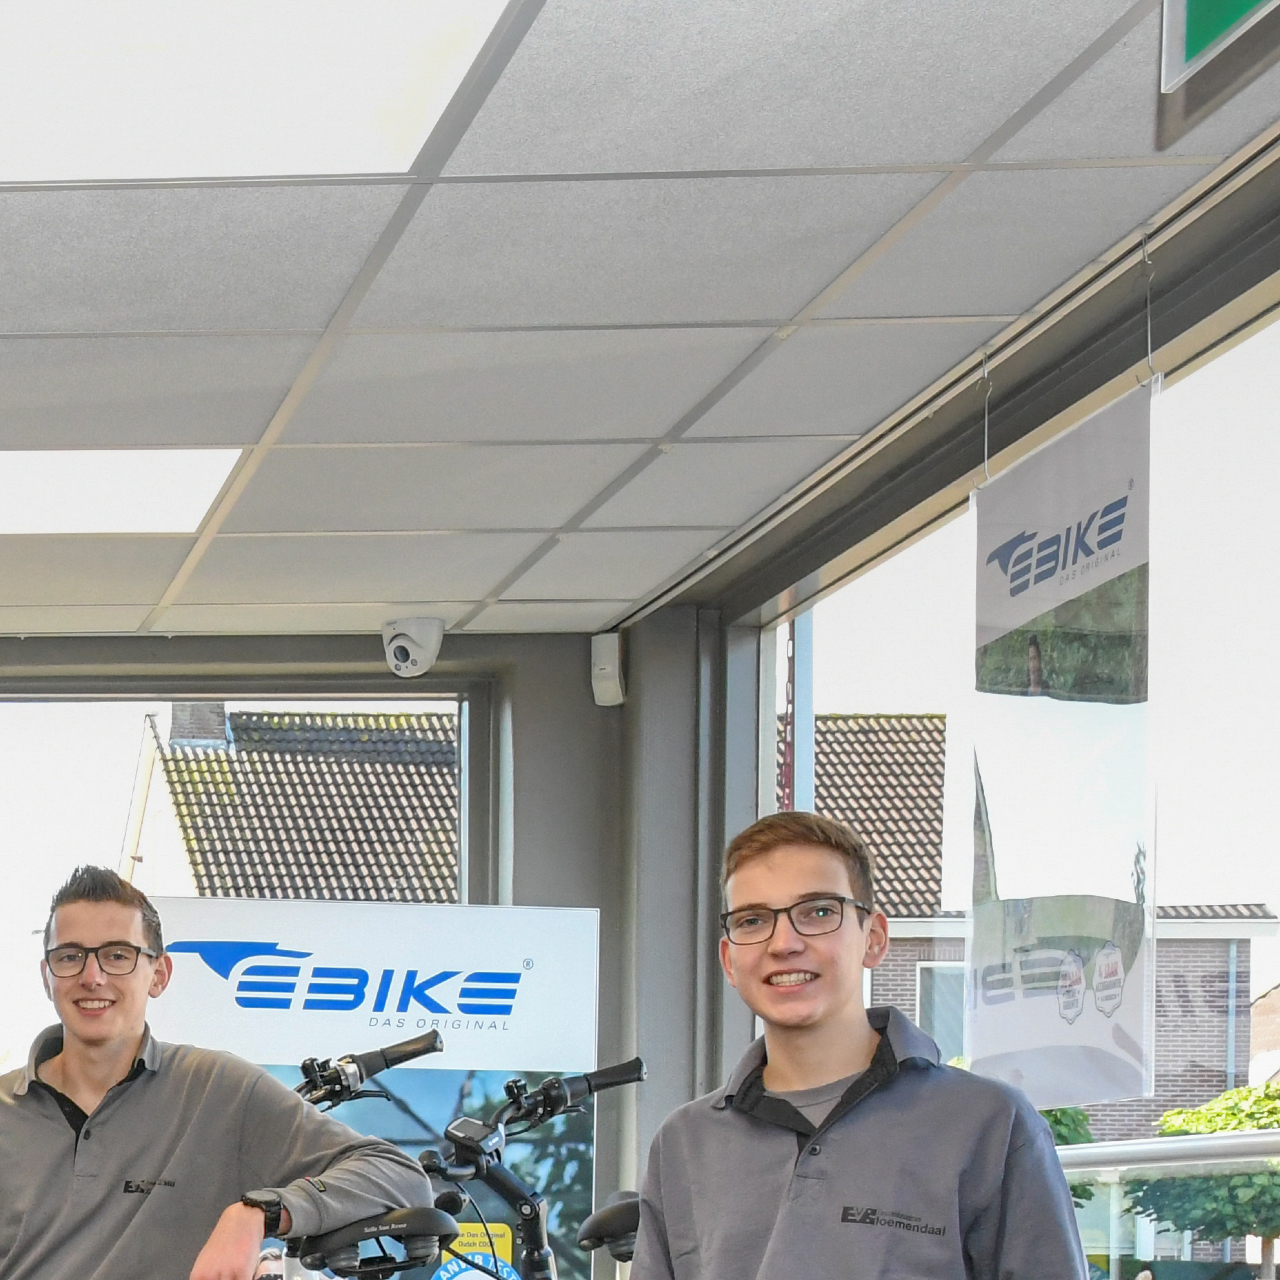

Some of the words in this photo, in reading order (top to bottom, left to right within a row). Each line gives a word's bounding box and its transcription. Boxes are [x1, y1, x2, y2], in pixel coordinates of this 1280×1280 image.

[1010, 495, 1128, 597] EBIKE
[234, 964, 522, 1015] EBIKE
[368, 1017, 405, 1028] DAS
[416, 1019, 509, 1031] ORIGINAL
[480, 1231, 505, 1241] Oginal
